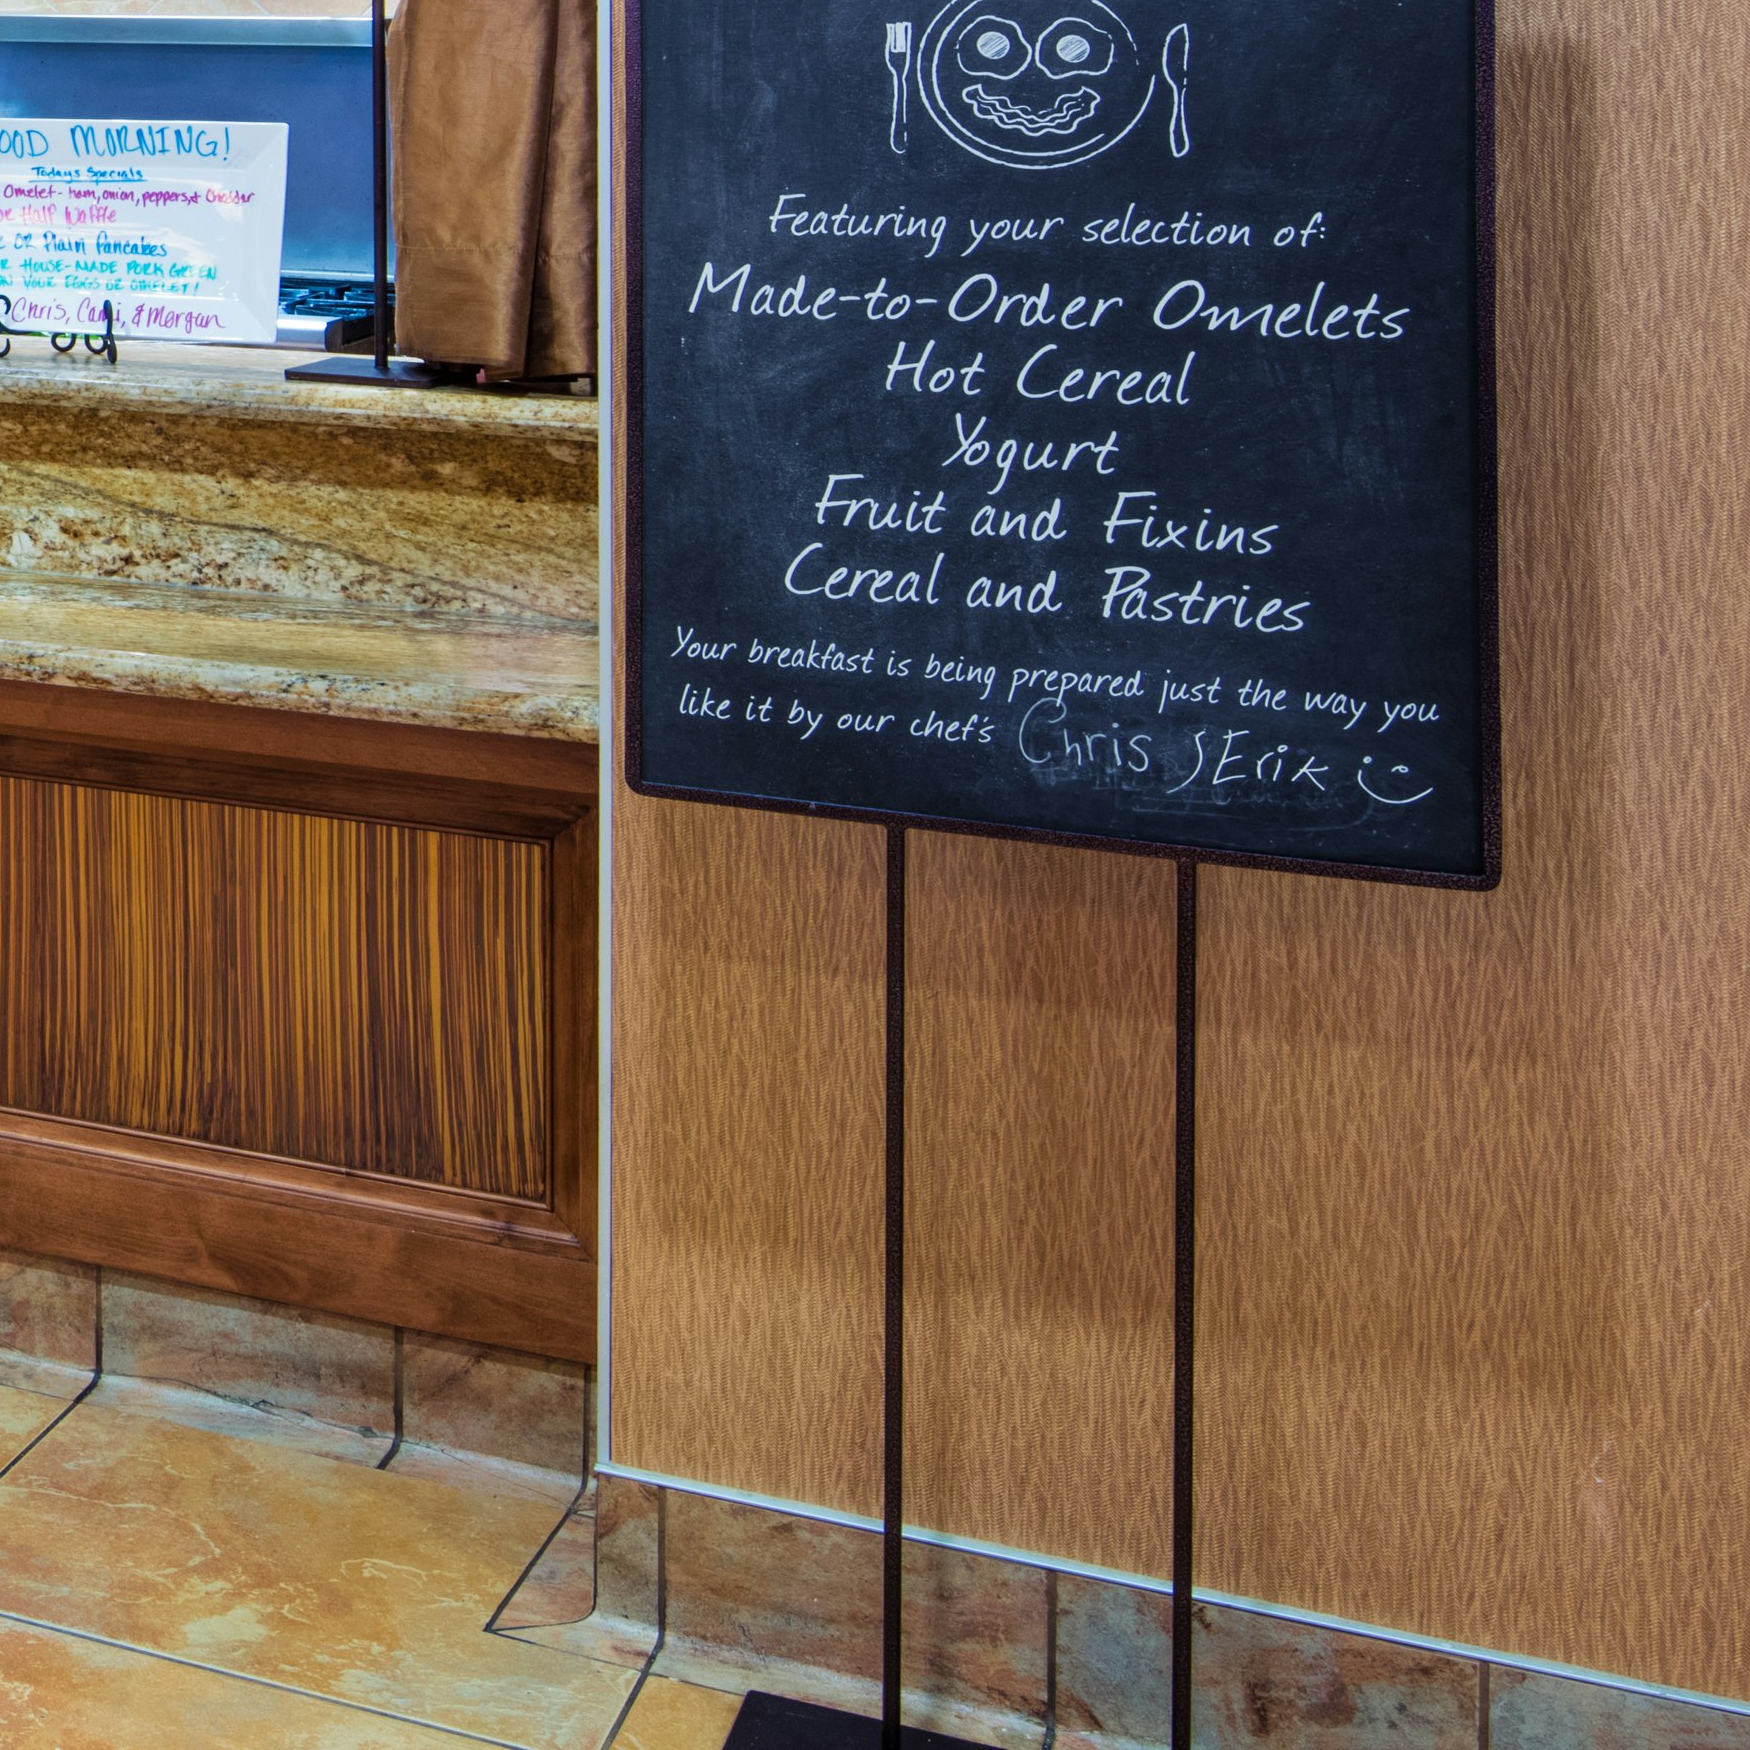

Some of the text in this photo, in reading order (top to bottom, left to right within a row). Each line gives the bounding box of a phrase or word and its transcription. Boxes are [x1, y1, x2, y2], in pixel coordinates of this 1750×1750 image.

[69, 124, 230, 162] MORNING!
[86, 165, 144, 187] Specials
[13, 233, 37, 250] OR
[43, 230, 87, 255] Plain
[96, 231, 168, 257] Pancakes
[65, 204, 117, 225] Waffle
[768, 193, 1326, 259] Featuring your selection of:
[106, 277, 124, 291] OR
[126, 259, 164, 277] PORK
[11, 297, 70, 324] Chris,
[146, 306, 226, 334] Morgan
[688, 261, 1410, 340] Made-to-Order Omelets
[885, 339, 1196, 405] Hot Cereal
[938, 412, 1123, 497] Yogurt
[814, 473, 1279, 555] Fruit and Fixins
[784, 542, 1311, 633] Cereal and Pastries
[670, 625, 1441, 732] Your breakfast is being prepared just the way you
[679, 683, 995, 743] like it by our chef's
[1018, 697, 1152, 772] Chris
